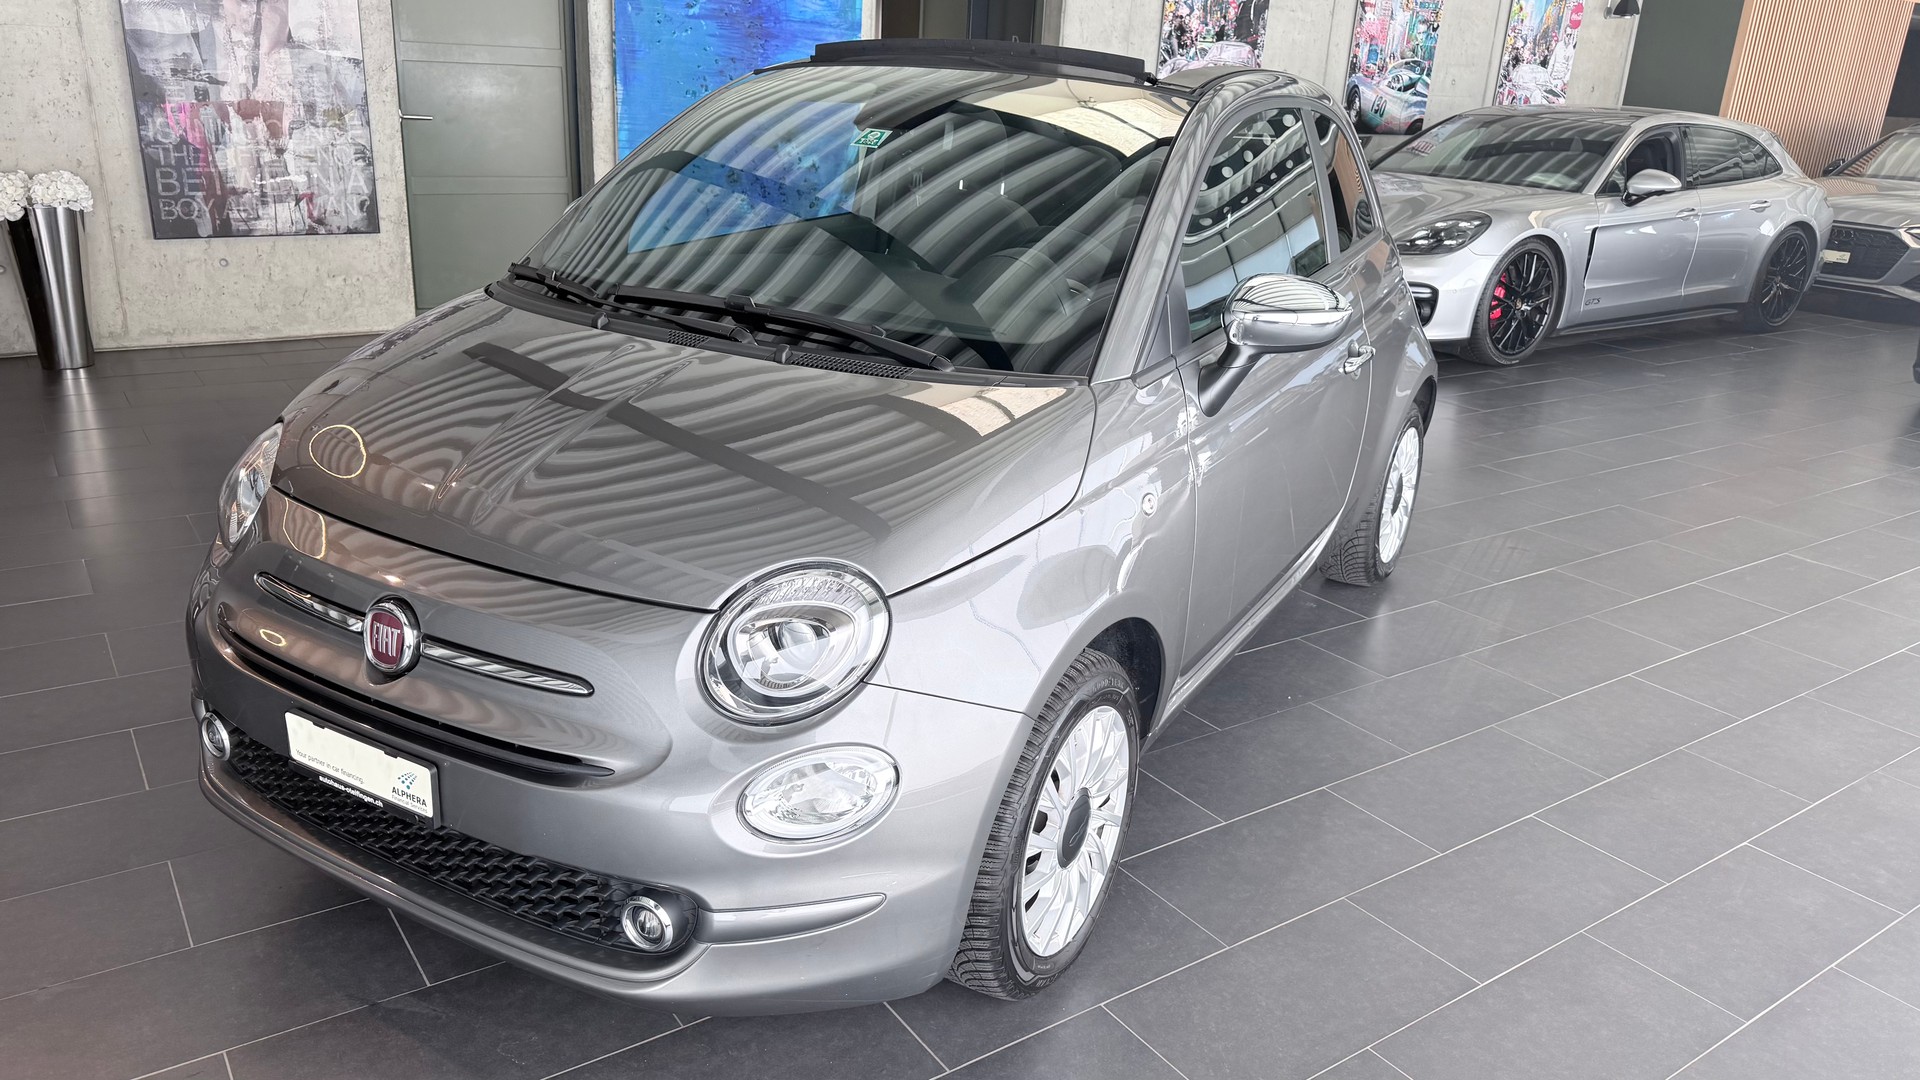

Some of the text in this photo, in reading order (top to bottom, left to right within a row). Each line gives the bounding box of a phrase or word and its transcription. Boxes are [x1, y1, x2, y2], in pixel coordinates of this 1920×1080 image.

[1370, 95, 1387, 118] 130
[151, 143, 207, 167] THE
[160, 197, 216, 221] BOY
[1585, 297, 1601, 306] GTS
[372, 620, 401, 657] FIAT
[307, 754, 326, 767] partner
[326, 761, 332, 770] in
[331, 765, 340, 774] car
[391, 786, 428, 808] ALPHERA
